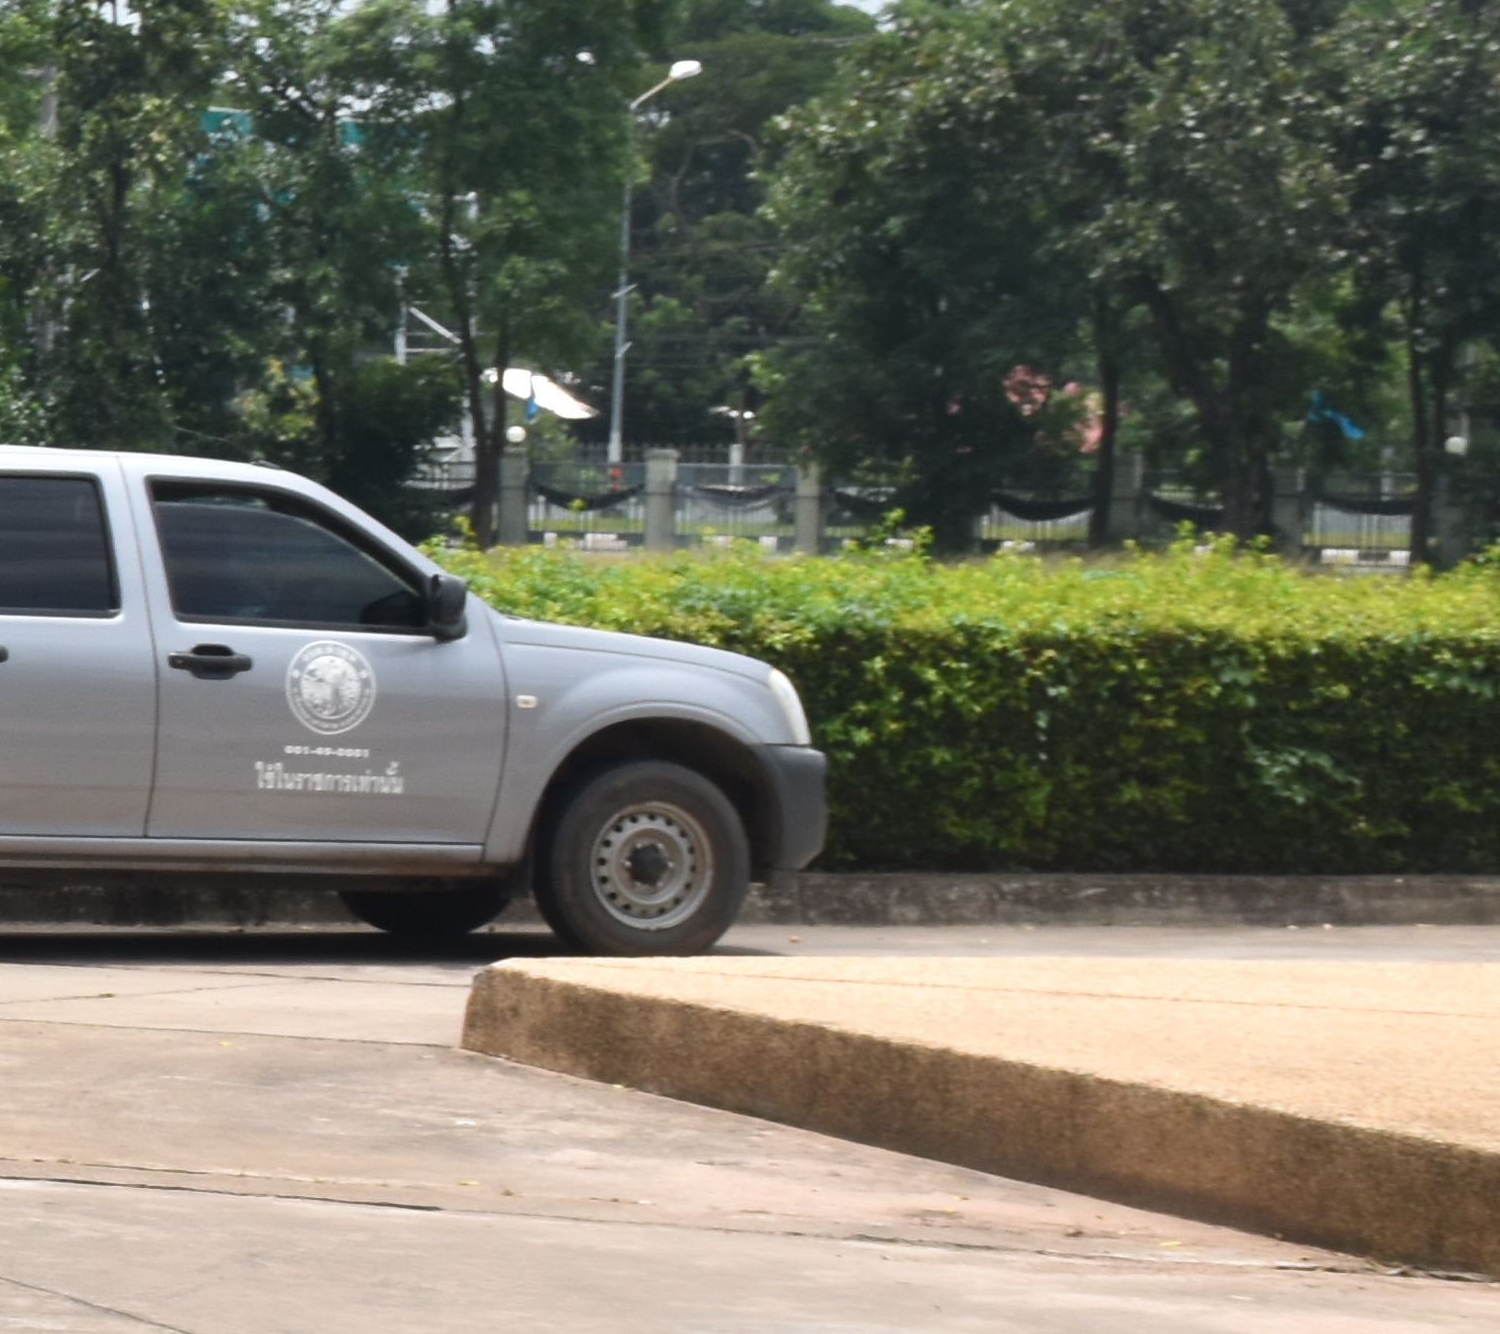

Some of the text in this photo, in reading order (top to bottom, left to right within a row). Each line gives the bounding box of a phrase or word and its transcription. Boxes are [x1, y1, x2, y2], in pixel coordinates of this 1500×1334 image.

[255, 761, 404, 794] ใช้ในราชการเท่านั้น
